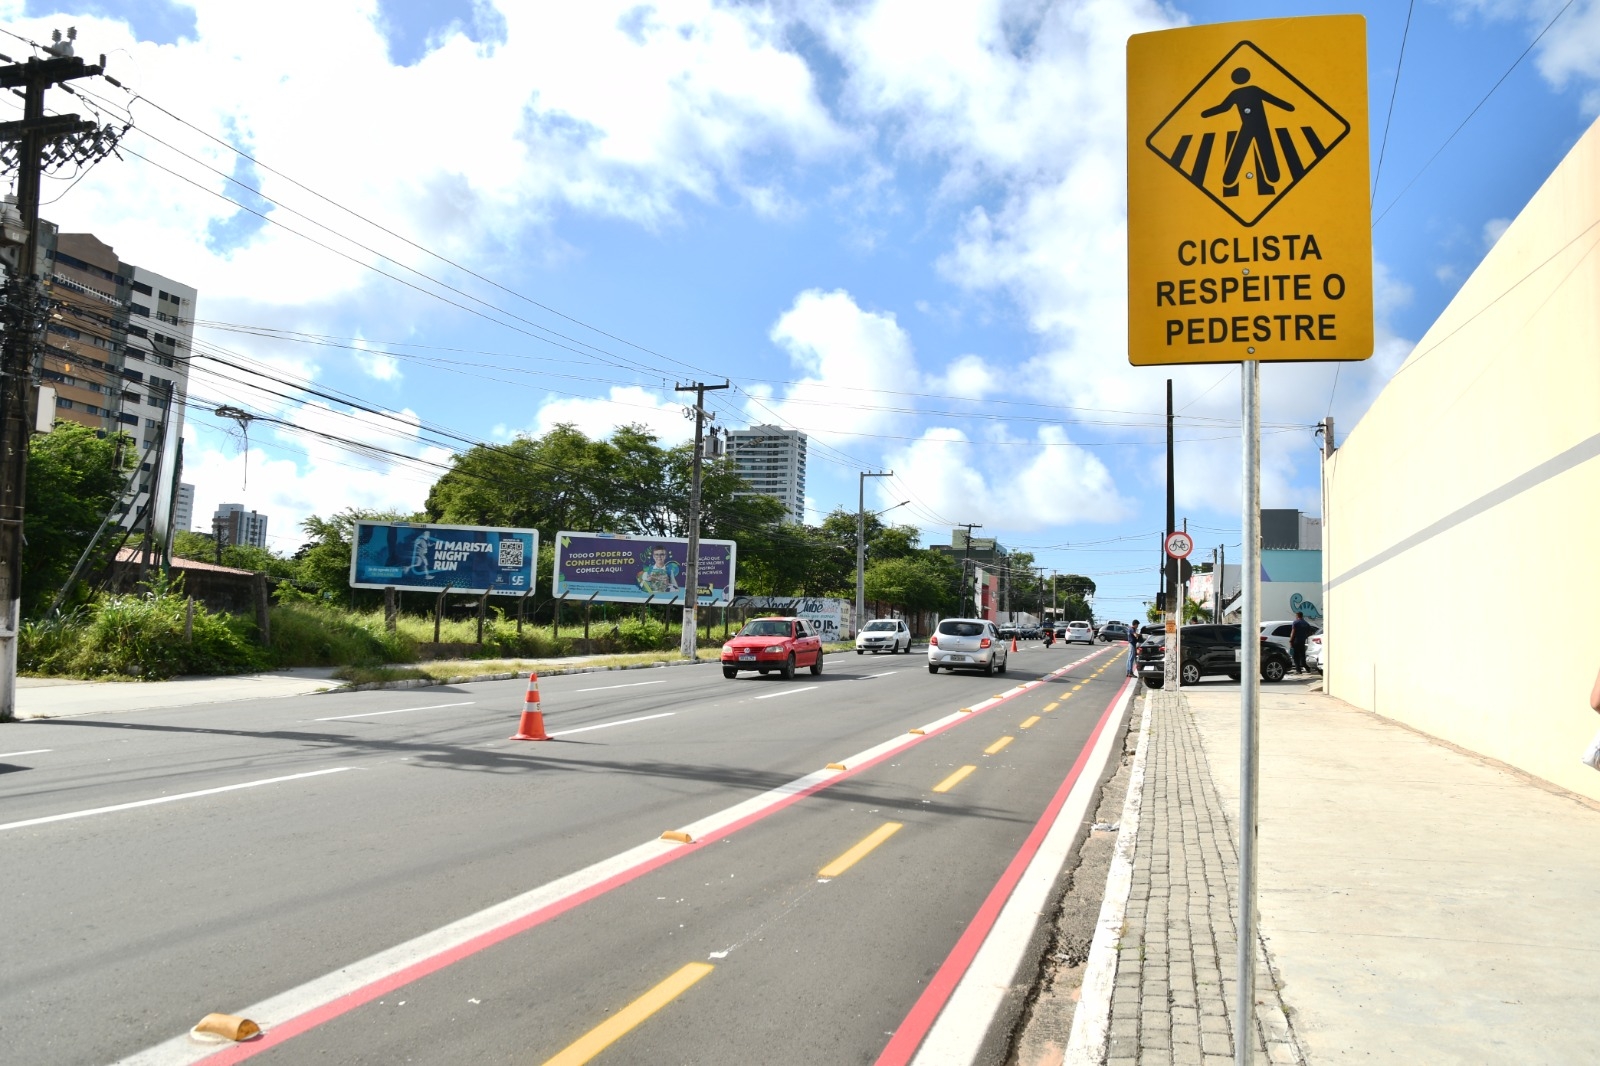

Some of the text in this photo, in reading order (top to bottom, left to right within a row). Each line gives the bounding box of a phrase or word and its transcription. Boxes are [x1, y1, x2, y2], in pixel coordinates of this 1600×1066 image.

[1178, 234, 1323, 266] CICLISTA
[1157, 273, 1346, 307] RESPEITE O
[1166, 314, 1337, 346] PEDESTRE
[444, 541, 493, 552] MARISTA
[434, 551, 470, 561] NIGHT
[433, 560, 458, 571] RUN
[565, 558, 635, 567] CONHECIMENTO
[823, 620, 838, 630] JR.
